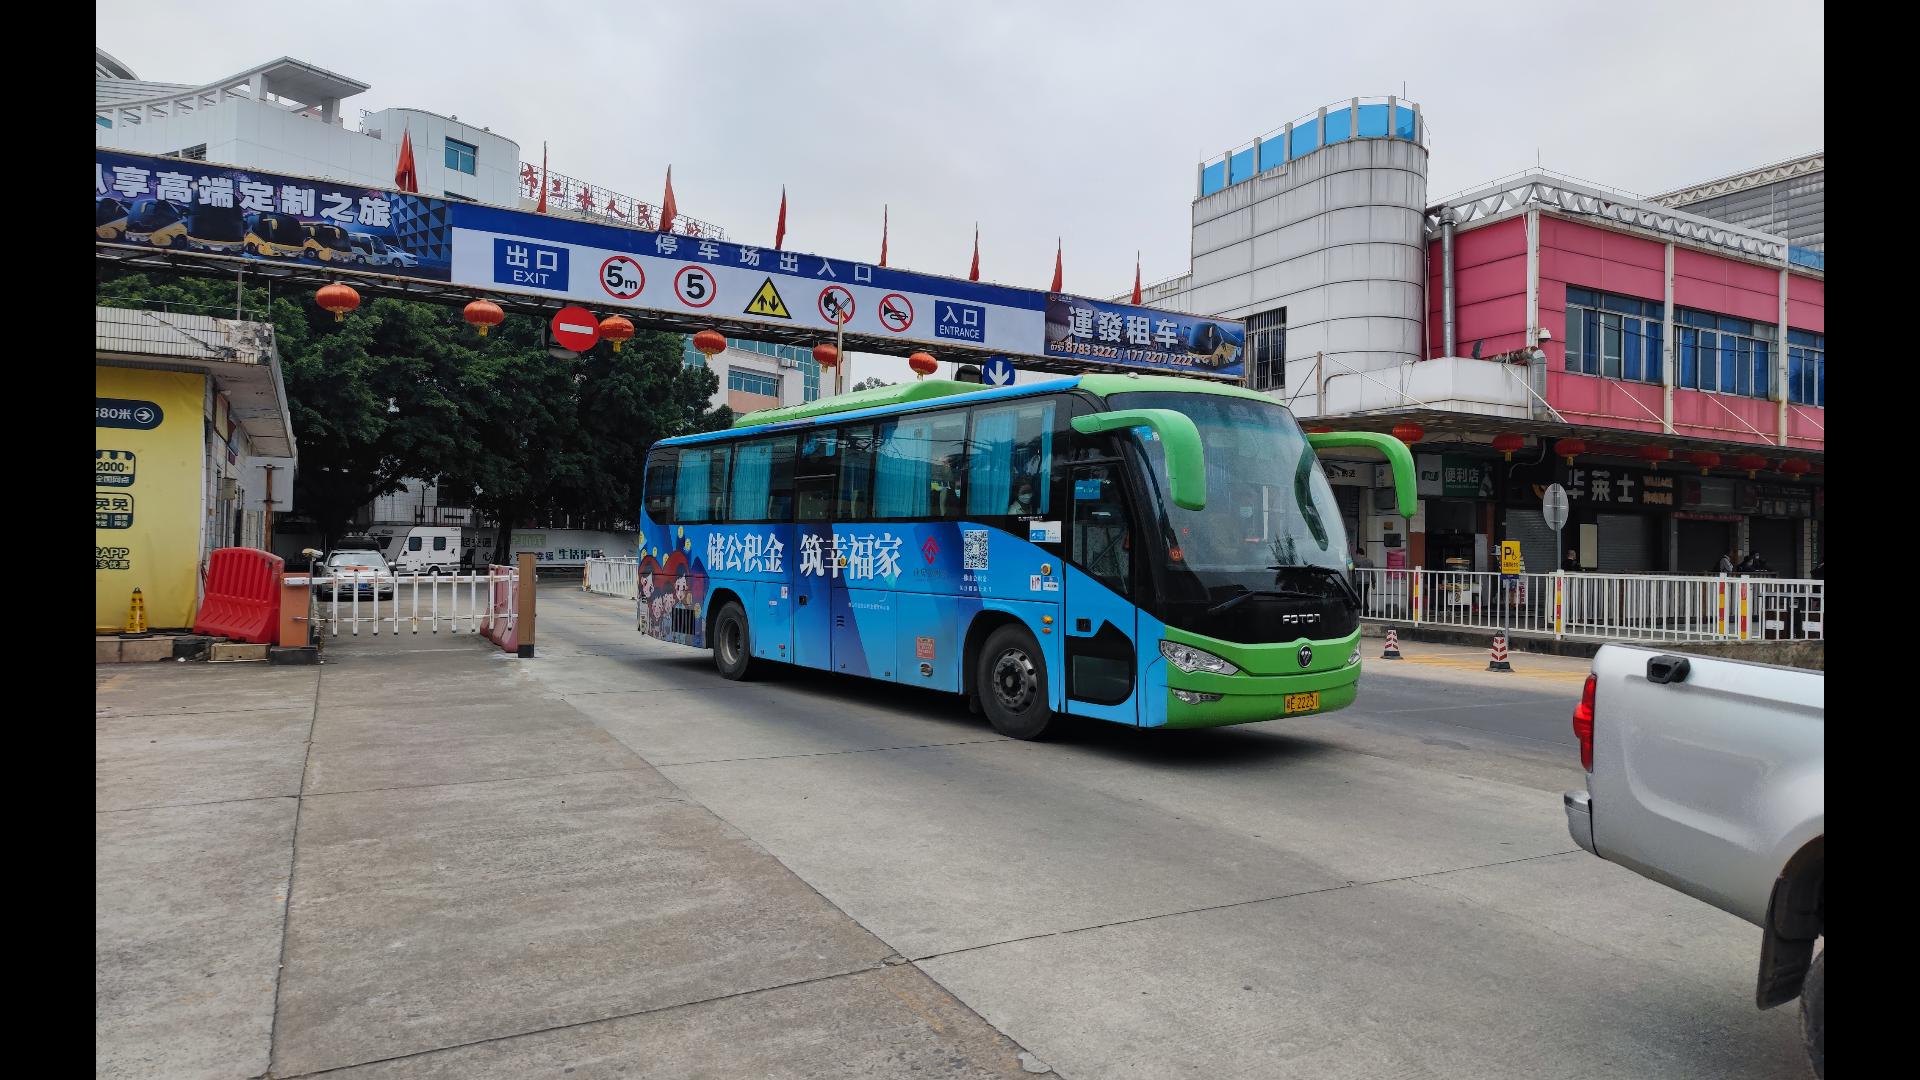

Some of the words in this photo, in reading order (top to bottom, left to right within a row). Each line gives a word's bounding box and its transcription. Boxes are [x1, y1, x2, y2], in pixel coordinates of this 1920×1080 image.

[506, 244, 558, 272] 出口
[655, 233, 872, 283] 停车场出入口
[513, 270, 550, 285] EXIT
[606, 265, 638, 290] 5m
[686, 273, 705, 300] 5
[942, 305, 978, 326] 入口
[1068, 306, 1179, 349] 運發租车
[939, 323, 980, 340] ENTRANCE
[1065, 341, 1091, 355] 8783
[1092, 345, 1118, 359] 3222
[1126, 349, 1144, 361] 177
[1170, 353, 1193, 367] 2222
[1445, 467, 1479, 483] 便利店
[1567, 468, 1634, 503] 华莱士
[96, 560, 129, 569] 多优惠
[707, 532, 785, 574] 储公积金
[799, 533, 903, 581] 筑幸福家
[1282, 613, 1321, 625] FOTON
